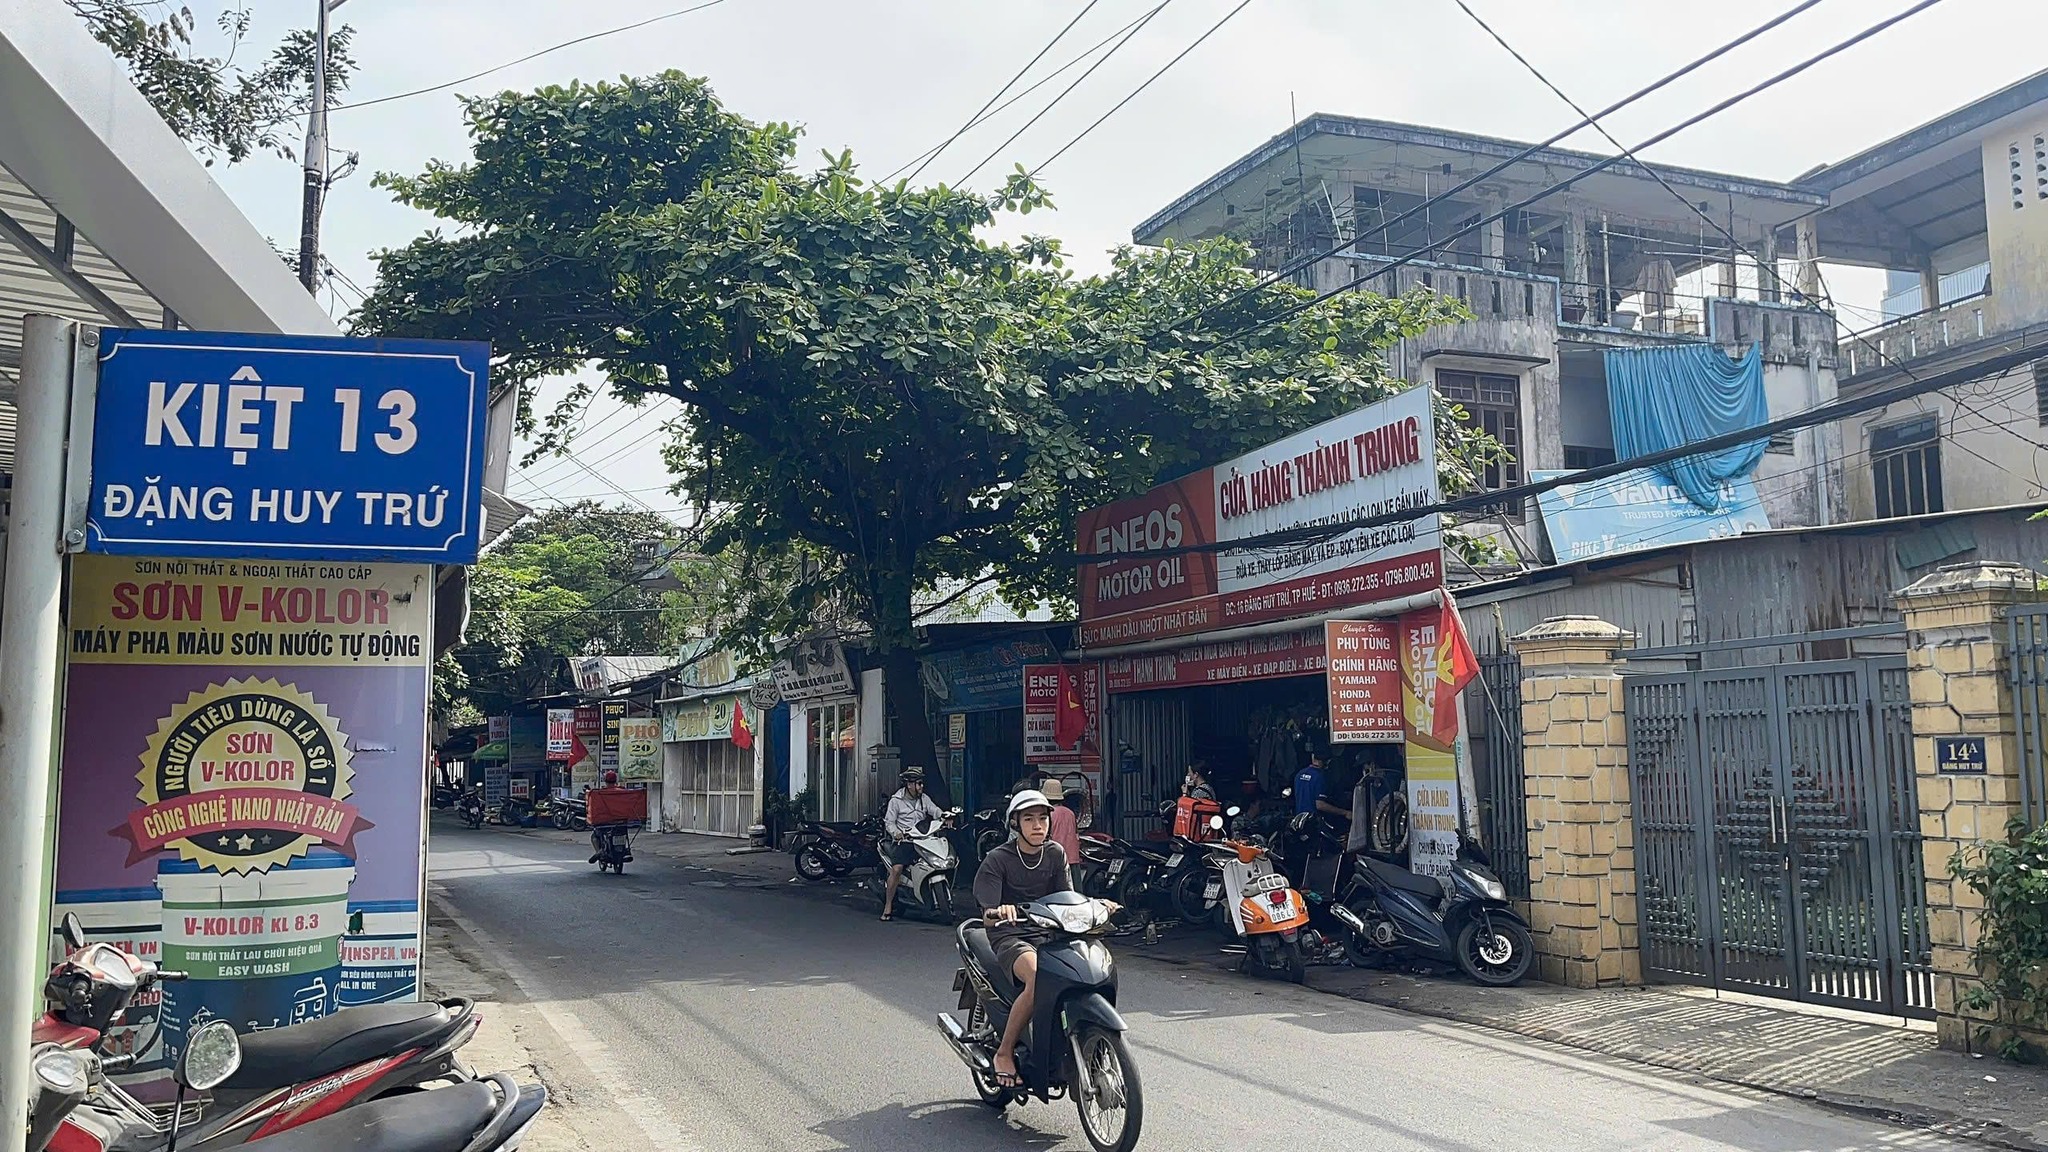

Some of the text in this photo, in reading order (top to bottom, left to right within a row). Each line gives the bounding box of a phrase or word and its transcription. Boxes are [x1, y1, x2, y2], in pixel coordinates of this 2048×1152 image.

[144, 365, 418, 465] KIỆT 13
[1220, 415, 1420, 520] CỬA HÀNG THÀNH TRUNG
[103, 475, 450, 528] ĐẶNG HUY TRỨ
[1606, 481, 1737, 506] Valvoe
[1622, 510, 1664, 520] TRUSTED
[1095, 503, 1183, 568] ENEOS
[1570, 536, 1600, 557] BIKE
[135, 561, 372, 580] SƠN NỘI THẤT & NGOẠI THẤT CAO CẤP
[1098, 557, 1185, 602] MOTOR OIL
[1262, 593, 1275, 609] HUY
[1292, 588, 1301, 603] TP
[1334, 575, 1380, 596] 0936.272.355
[1385, 561, 1435, 587] 0796.800.424
[111, 580, 389, 625] SƠN V-KOLOR
[1083, 626, 1099, 644] SỨC
[1163, 609, 1187, 632] NHẬT
[1188, 605, 1208, 625] BẢN
[73, 625, 420, 662] MÁY PHA MÀU SƠN NƯỚC TỰ ĐỘNG
[1337, 634, 1391, 653] PHỤ TÙNG
[1253, 664, 1262, 676] XE
[1304, 657, 1314, 671] XE
[1331, 655, 1397, 672] CHÍNH HÃNG
[1029, 675, 1078, 687] ENES
[1339, 675, 1377, 685] YAMAHA
[1410, 629, 1425, 736] MOTOR OIL
[1029, 688, 1058, 697] MOTO
[1339, 689, 1371, 699] HONDA
[605, 704, 625, 716] PHỤC
[714, 702, 727, 720] 20
[1088, 669, 1097, 743] ENEOS
[1340, 701, 1399, 714] XE MÁY ĐIỆN
[606, 720, 620, 729] SIN
[1342, 715, 1399, 729] XE ĐẠP ĐIỆN
[163, 697, 335, 792] NGƯỜI TIÊU DÙNG LÀ SỐ 1
[226, 731, 274, 755] SƠN
[604, 734, 619, 744] LAPT
[1371, 731, 1385, 739] 272
[1386, 731, 1400, 739] 355
[632, 744, 651, 752] 20
[1947, 741, 1979, 761] 14A
[201, 760, 295, 782] V-KOLOR
[1416, 785, 1449, 807] CỬA HÀNG
[143, 795, 345, 840] CÔNG NGHỆ NANO NHẬT BẢN
[1412, 810, 1456, 832] THÀNH TRUNG
[184, 913, 319, 936] V-KOLOR KL 8.3
[219, 948, 241, 961] THẤT
[243, 950, 262, 960] LAU
[264, 947, 286, 960] CHÙI
[218, 962, 290, 977] EASY WASH
[340, 980, 377, 990] ALL IN ONE
